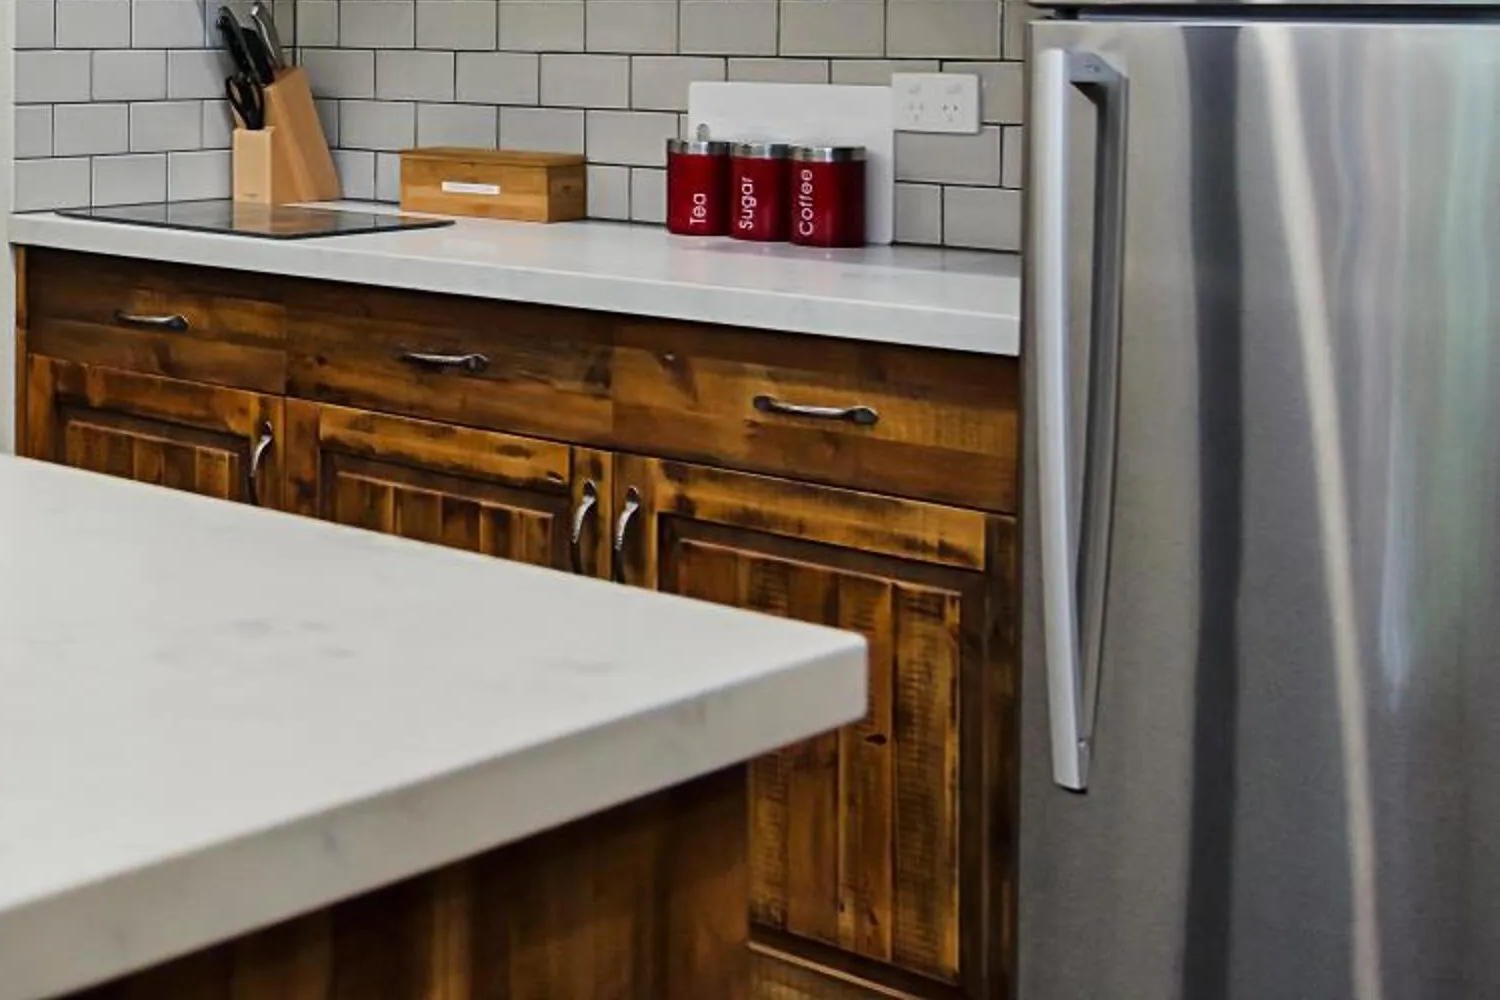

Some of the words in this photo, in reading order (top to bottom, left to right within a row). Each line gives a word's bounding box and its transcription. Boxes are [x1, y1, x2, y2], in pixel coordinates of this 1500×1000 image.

[689, 193, 707, 225] Tea
[739, 176, 757, 231] Sugar
[798, 169, 815, 237] Coffee
